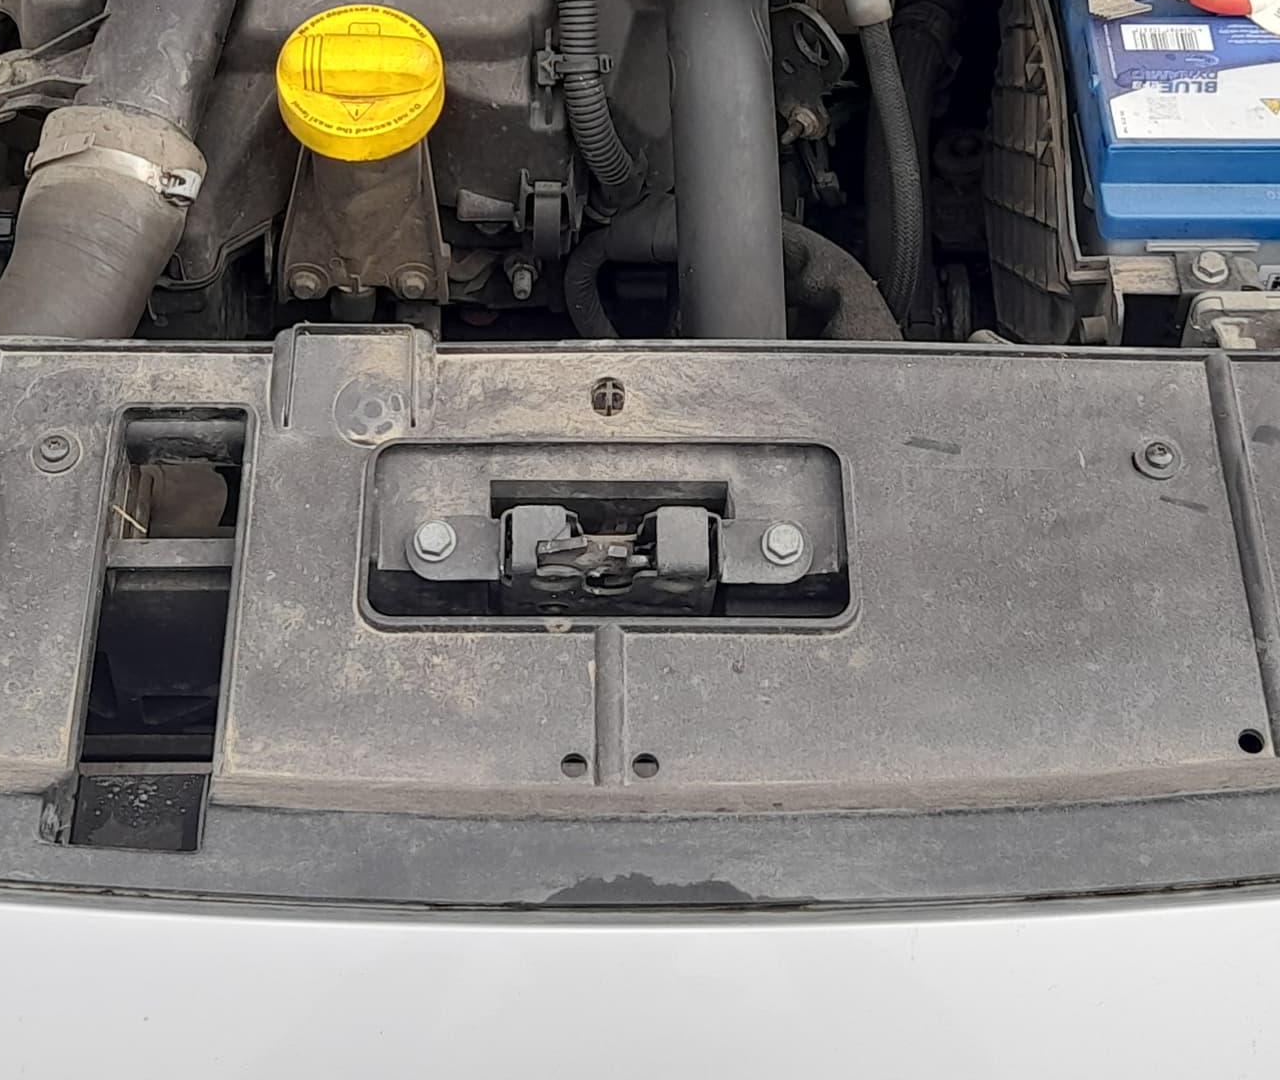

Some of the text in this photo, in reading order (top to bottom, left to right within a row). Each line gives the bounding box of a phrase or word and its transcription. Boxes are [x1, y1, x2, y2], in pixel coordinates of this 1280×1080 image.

[1160, 81, 1218, 94] BLUE
[291, 101, 422, 134] Do not exceed the maxi level
